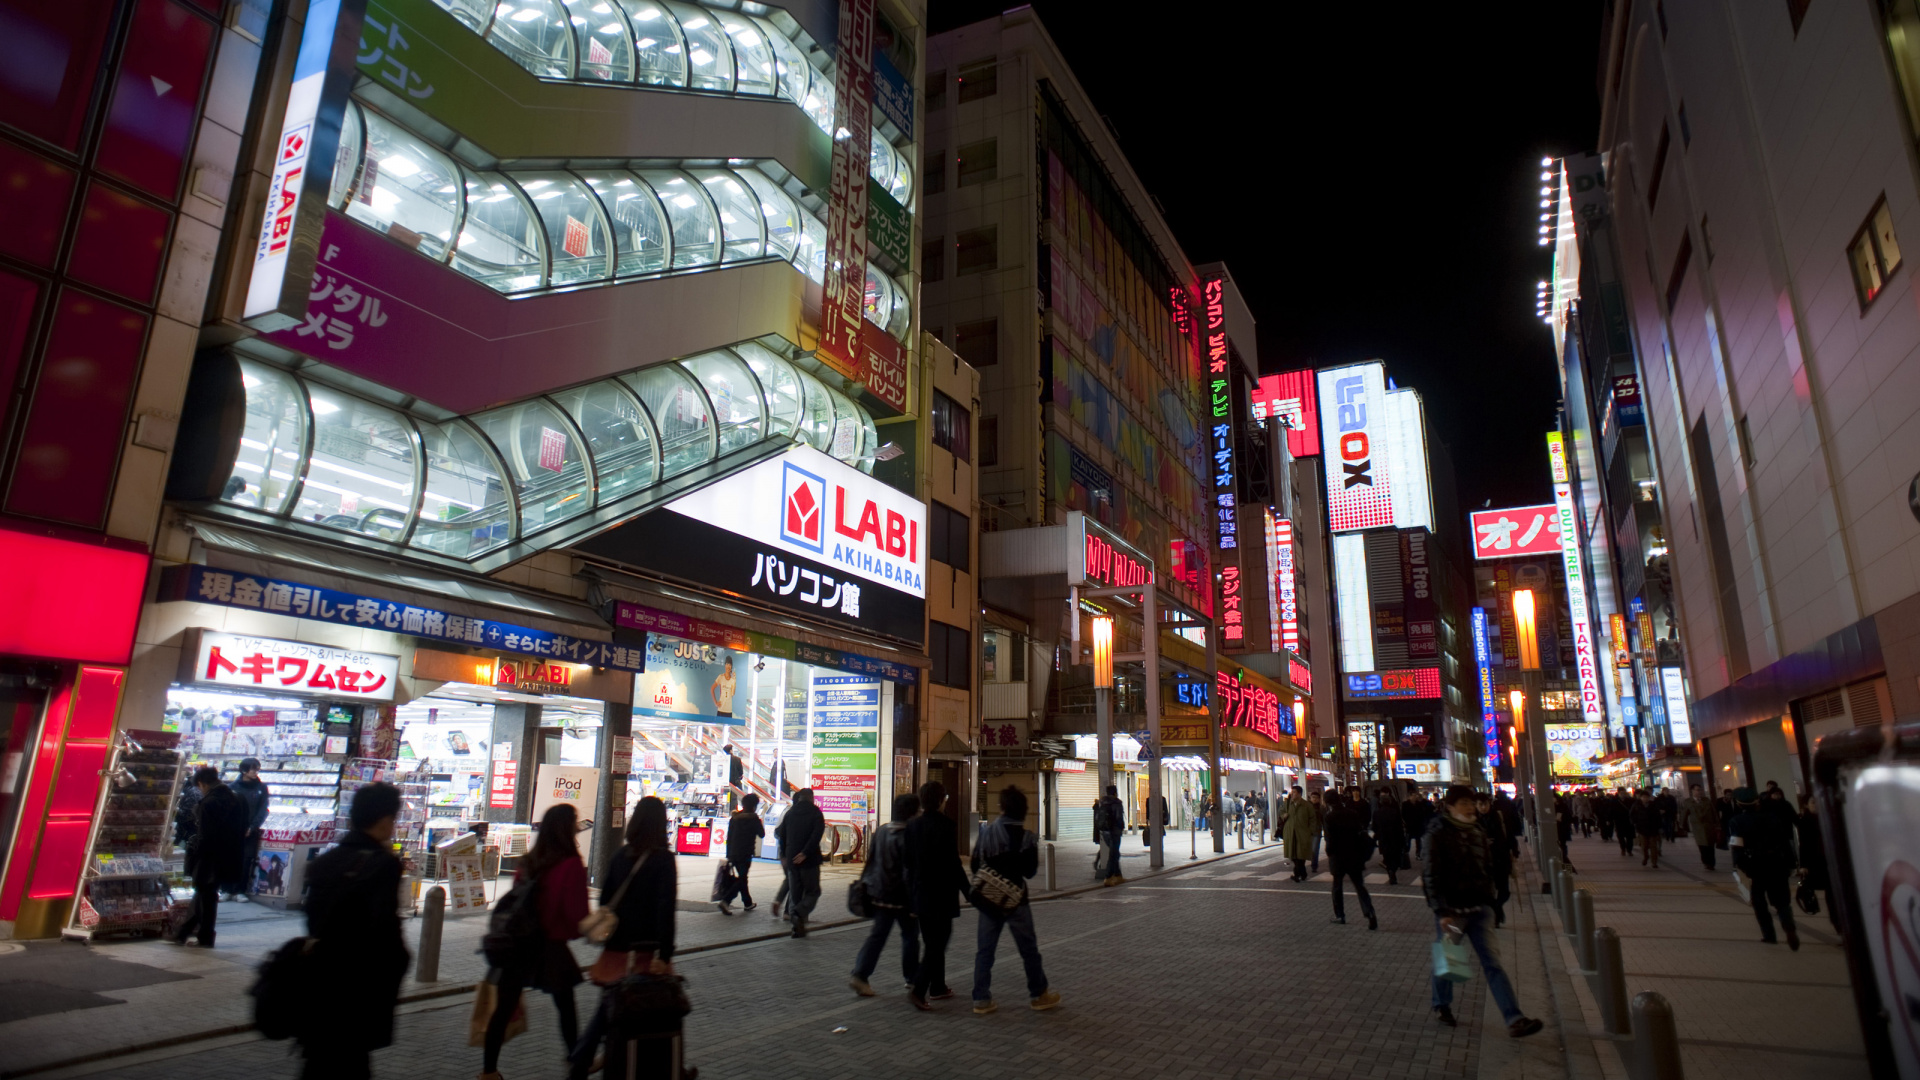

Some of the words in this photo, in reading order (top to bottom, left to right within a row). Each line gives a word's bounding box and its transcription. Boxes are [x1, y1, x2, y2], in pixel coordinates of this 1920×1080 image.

[258, 173, 282, 261] AKIHABARA
[269, 166, 302, 254] LABI
[1205, 279, 1223, 329] パソコン
[283, 311, 355, 350] メラ
[868, 351, 905, 388] モバイル
[1208, 332, 1227, 373] ビデオ
[868, 370, 905, 406] パソコン
[1211, 379, 1229, 417] テレビ
[1073, 454, 1111, 491] KAIYODO
[1213, 423, 1233, 486] オーディオ
[834, 484, 919, 564] LABI
[1561, 508, 1575, 544] DUTY
[833, 542, 922, 592] AKIHABARA
[1409, 532, 1426, 565] Duty
[1566, 547, 1580, 582] FREE
[751, 552, 861, 619] パソコン館
[1222, 566, 1243, 640] ラジオ会館
[1412, 566, 1429, 599] Free
[200, 570, 485, 643] 現金値引して安心価格保証
[504, 631, 641, 670] さらにポイント進呈
[1474, 612, 1487, 662] Panasonic
[205, 645, 387, 693] トキワムセン
[523, 660, 572, 686] LABI
[1480, 667, 1492, 708] ONODEN
[1575, 622, 1599, 714] TAKARADA
[654, 694, 673, 705] LABI
[1216, 670, 1279, 743] ラジオ会館
[1160, 725, 1207, 740] ラジオ会館
[554, 777, 582, 790] iPod
